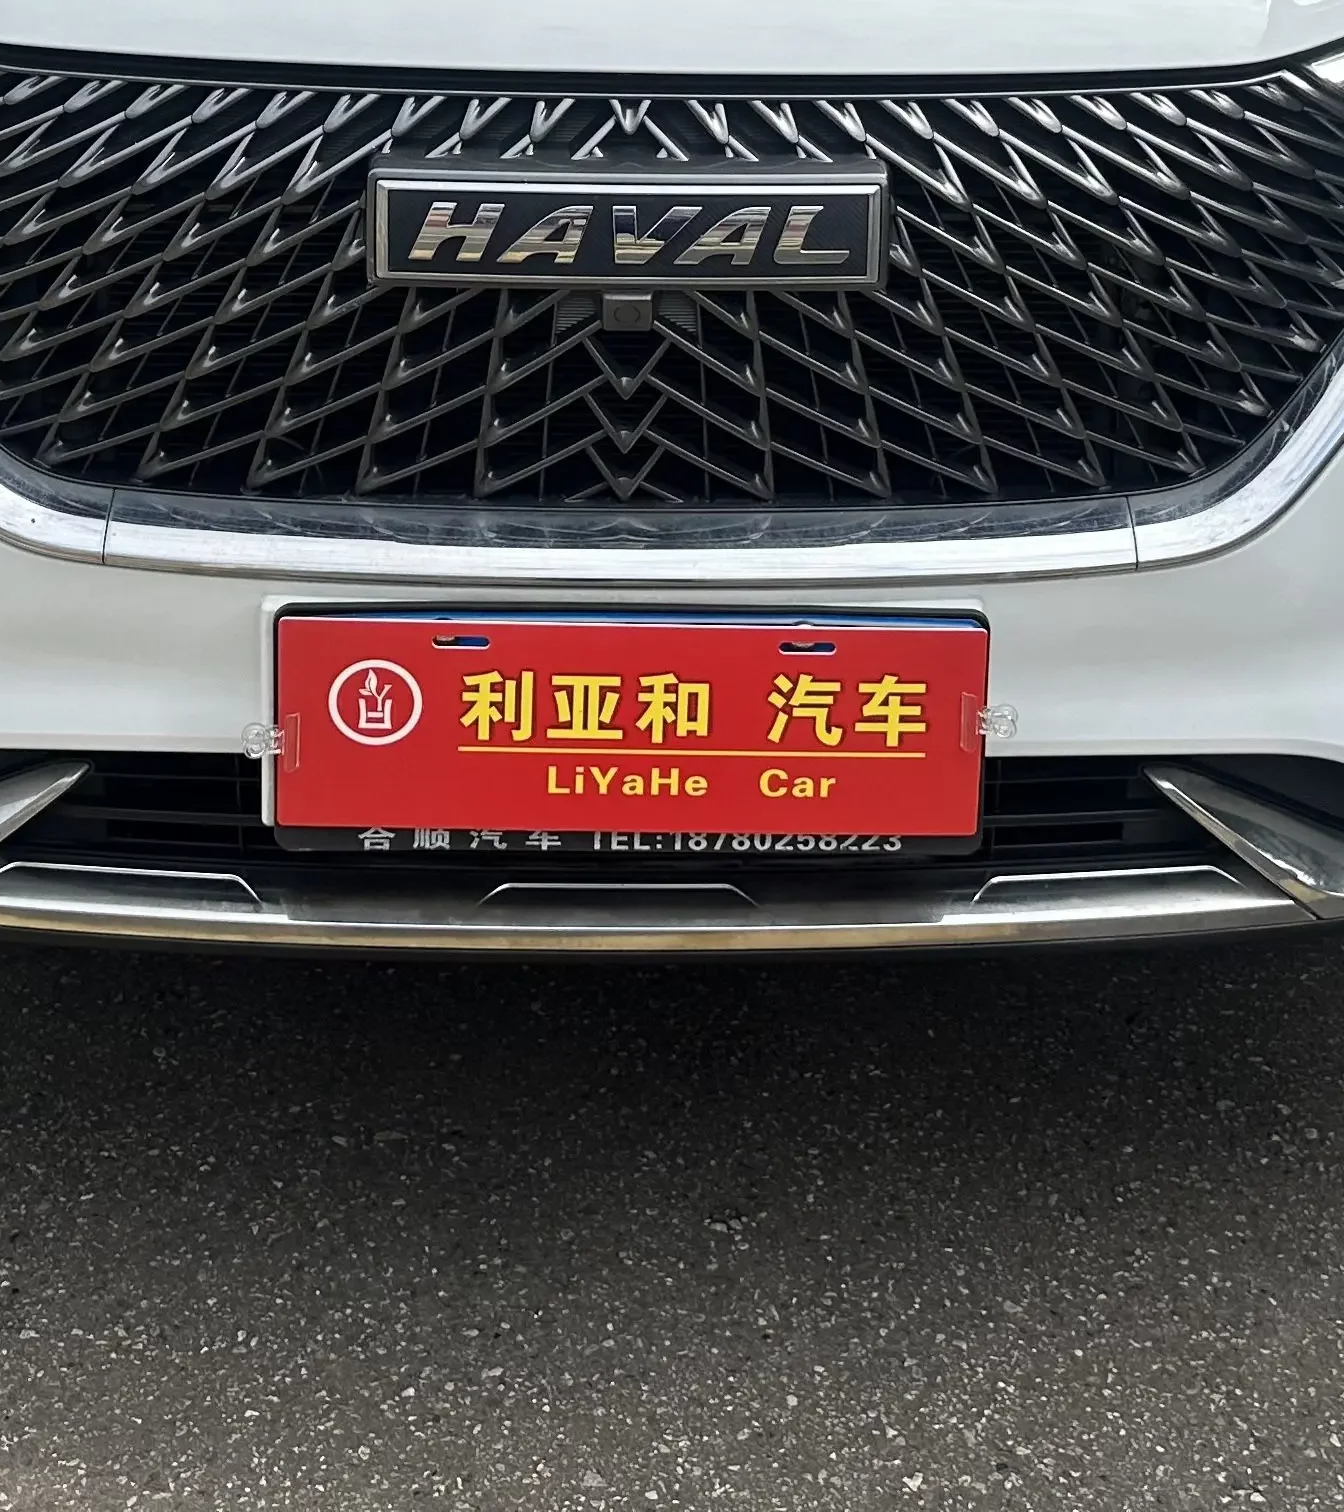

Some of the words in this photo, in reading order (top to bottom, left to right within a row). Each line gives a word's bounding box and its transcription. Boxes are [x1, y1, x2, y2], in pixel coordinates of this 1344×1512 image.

[408, 201, 850, 265] HAVAL
[460, 670, 709, 744] 利亚和
[766, 674, 927, 748] 汽车
[547, 766, 709, 798] LiYaHe
[759, 768, 836, 799] Car
